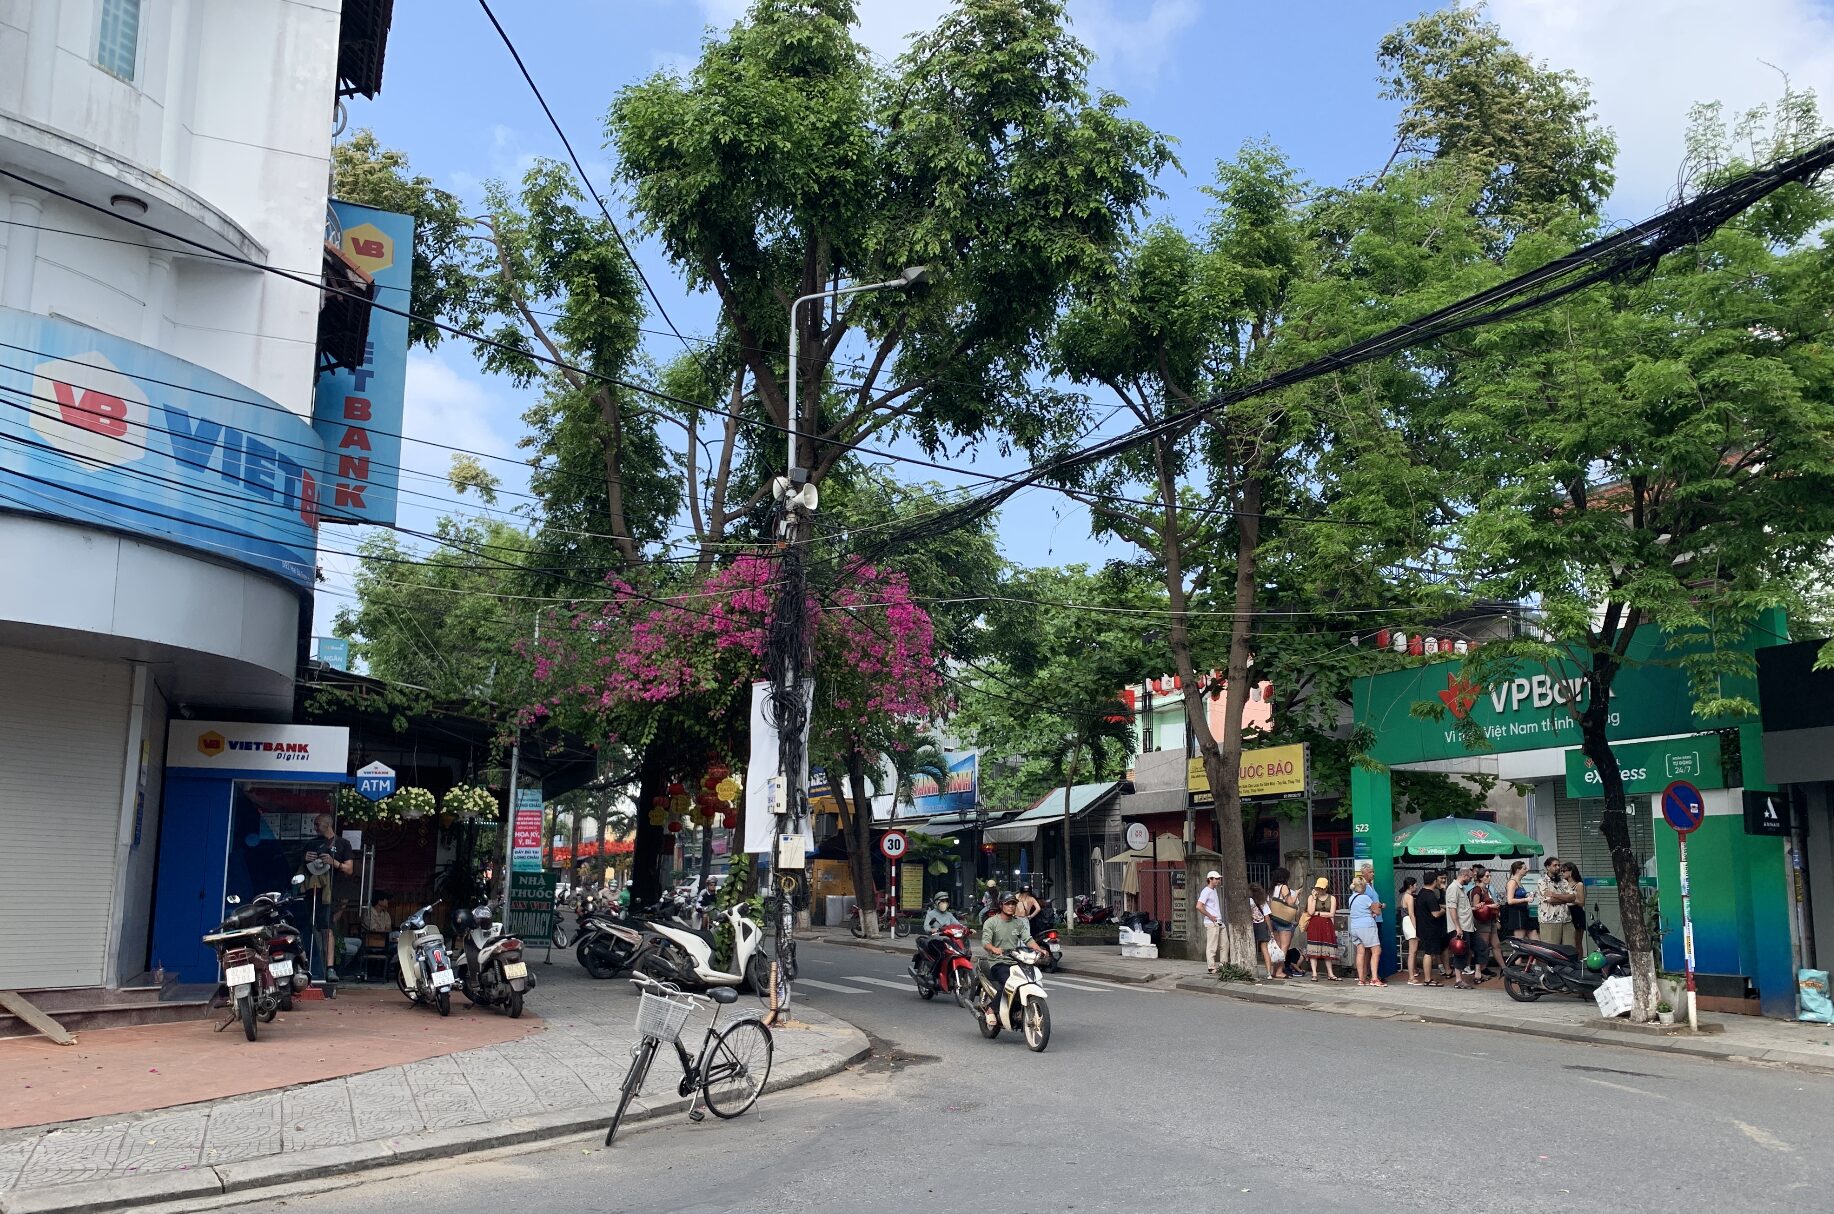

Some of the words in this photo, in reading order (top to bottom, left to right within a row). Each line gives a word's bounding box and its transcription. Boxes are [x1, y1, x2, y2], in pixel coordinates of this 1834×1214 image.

[1509, 722, 1539, 736] Nam
[1541, 716, 1574, 734] thịnh
[228, 740, 309, 753] VIETBANK
[276, 752, 310, 762] Digital
[1238, 763, 1265, 779] UỐC
[1584, 767, 1647, 784] exess
[1675, 765, 1691, 774] 24/7
[360, 779, 391, 792] ATM
[1355, 824, 1369, 833] 523
[887, 838, 901, 851] 30
[519, 874, 546, 886] NHÀ
[511, 886, 553, 899] THUỐC
